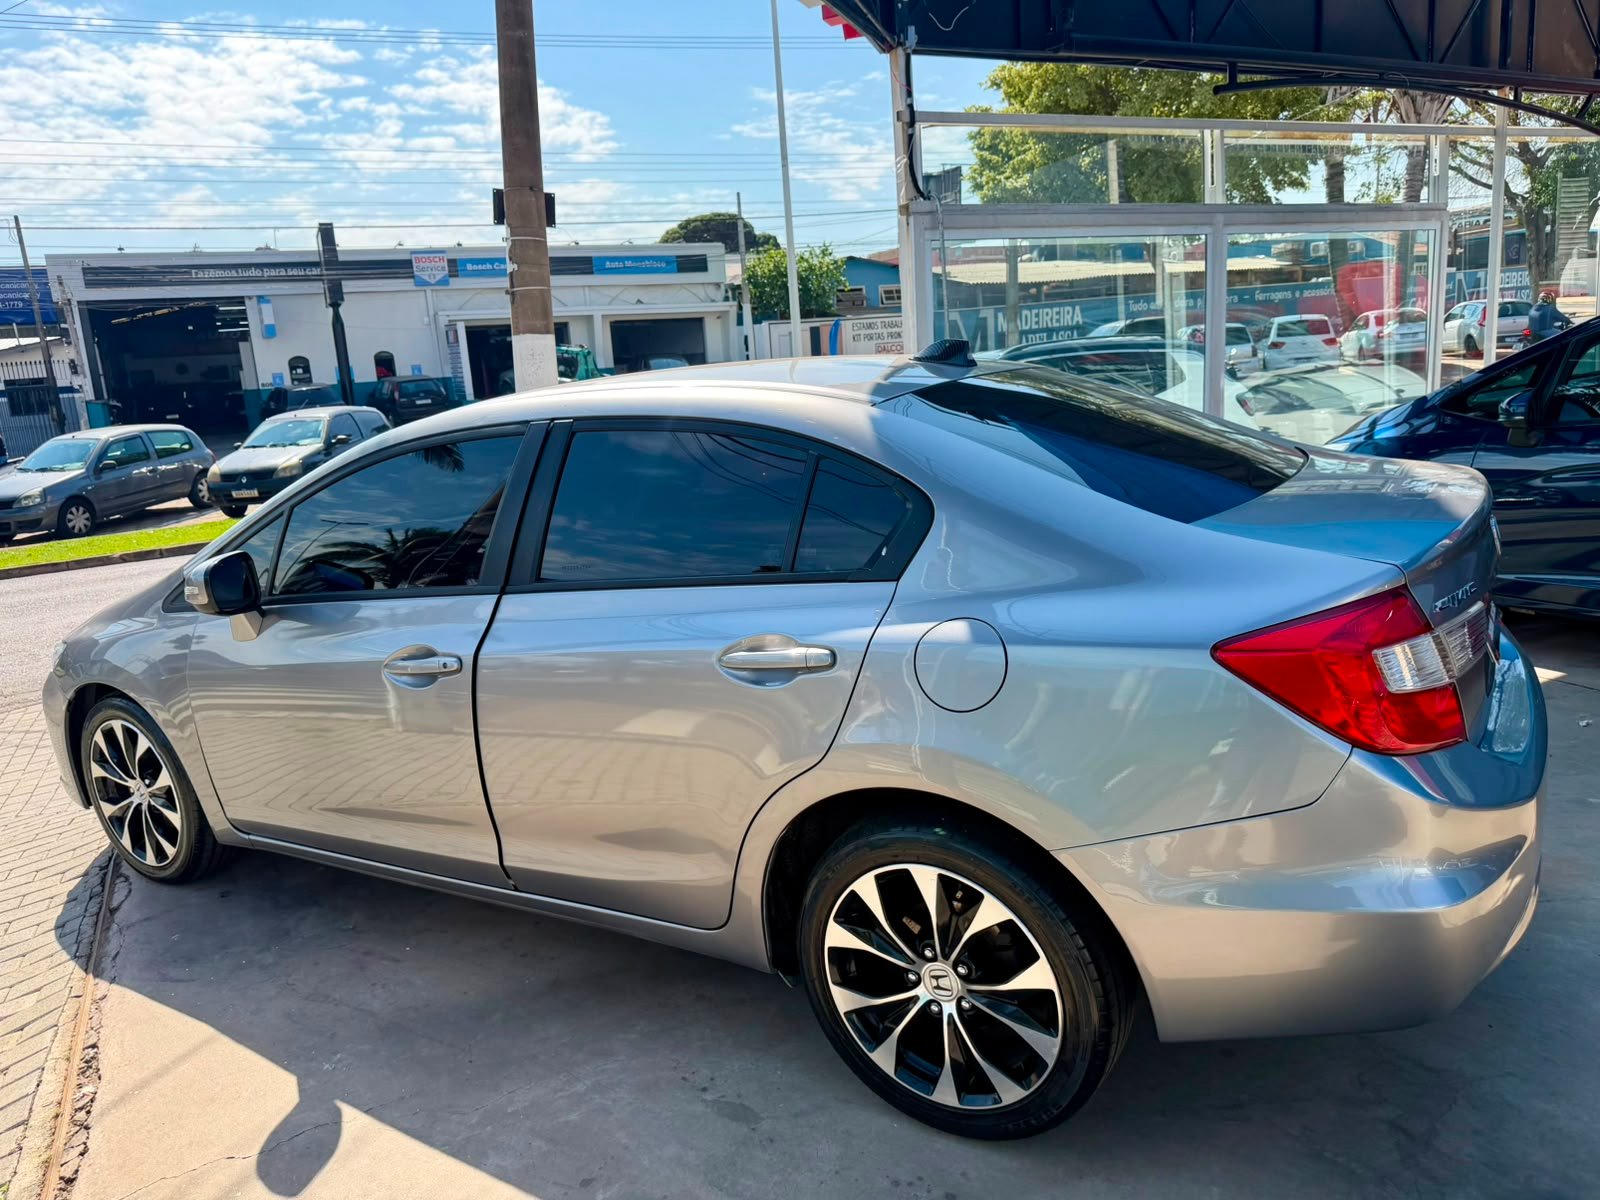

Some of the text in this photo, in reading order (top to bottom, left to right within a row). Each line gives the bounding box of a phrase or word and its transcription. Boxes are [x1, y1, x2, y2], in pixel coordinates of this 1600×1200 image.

[414, 255, 445, 264] BOSCH
[191, 266, 321, 278] Fazemos tudo para seu car
[415, 263, 446, 273] Service
[1128, 300, 1148, 311] Tudo
[1255, 290, 1292, 302] Ferragens
[998, 305, 1083, 333] MDEIREIRA
[852, 321, 879, 331] ESTAMOS
[852, 331, 903, 342] KIT PORTAS PRON
[877, 344, 904, 353] DALCO
